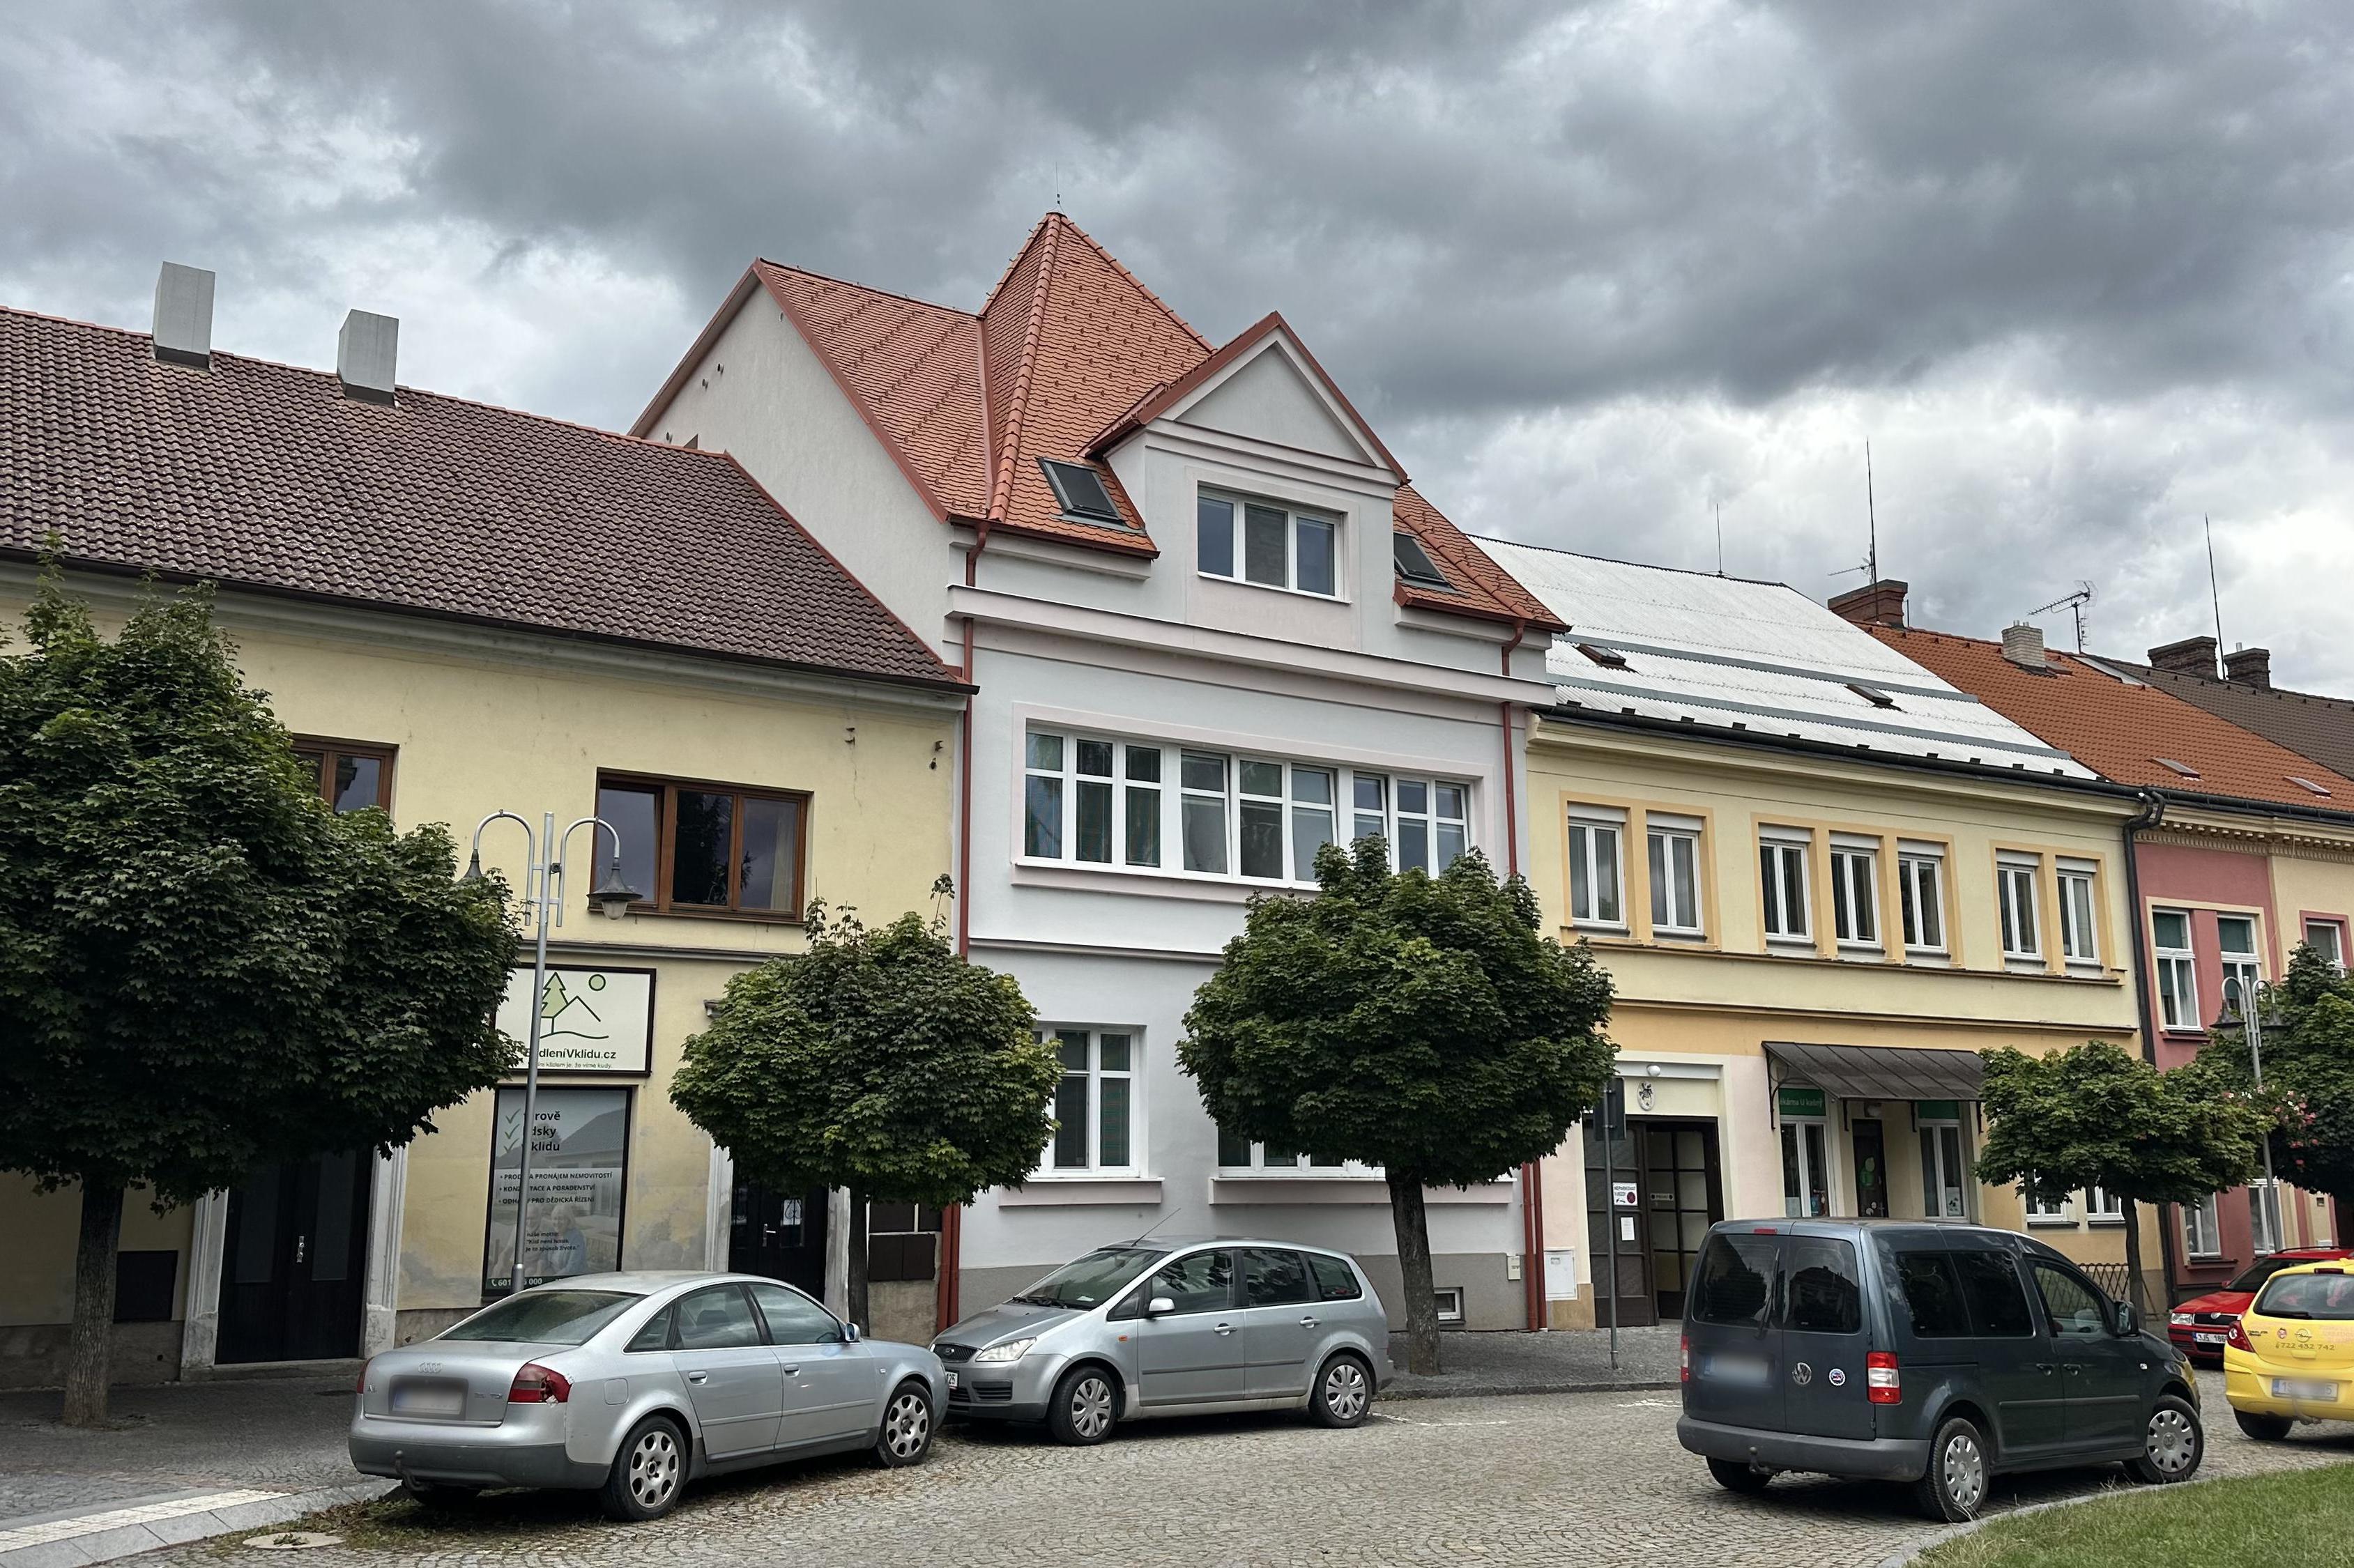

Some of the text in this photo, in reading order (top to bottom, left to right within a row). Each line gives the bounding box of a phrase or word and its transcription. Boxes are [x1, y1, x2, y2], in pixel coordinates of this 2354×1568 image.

[531, 1142, 560, 1151] klidu
[535, 1172, 569, 1181] PRONÁJEM
[546, 1195, 573, 1204] DĚDICKÁ
[529, 1277, 542, 1286] 000
